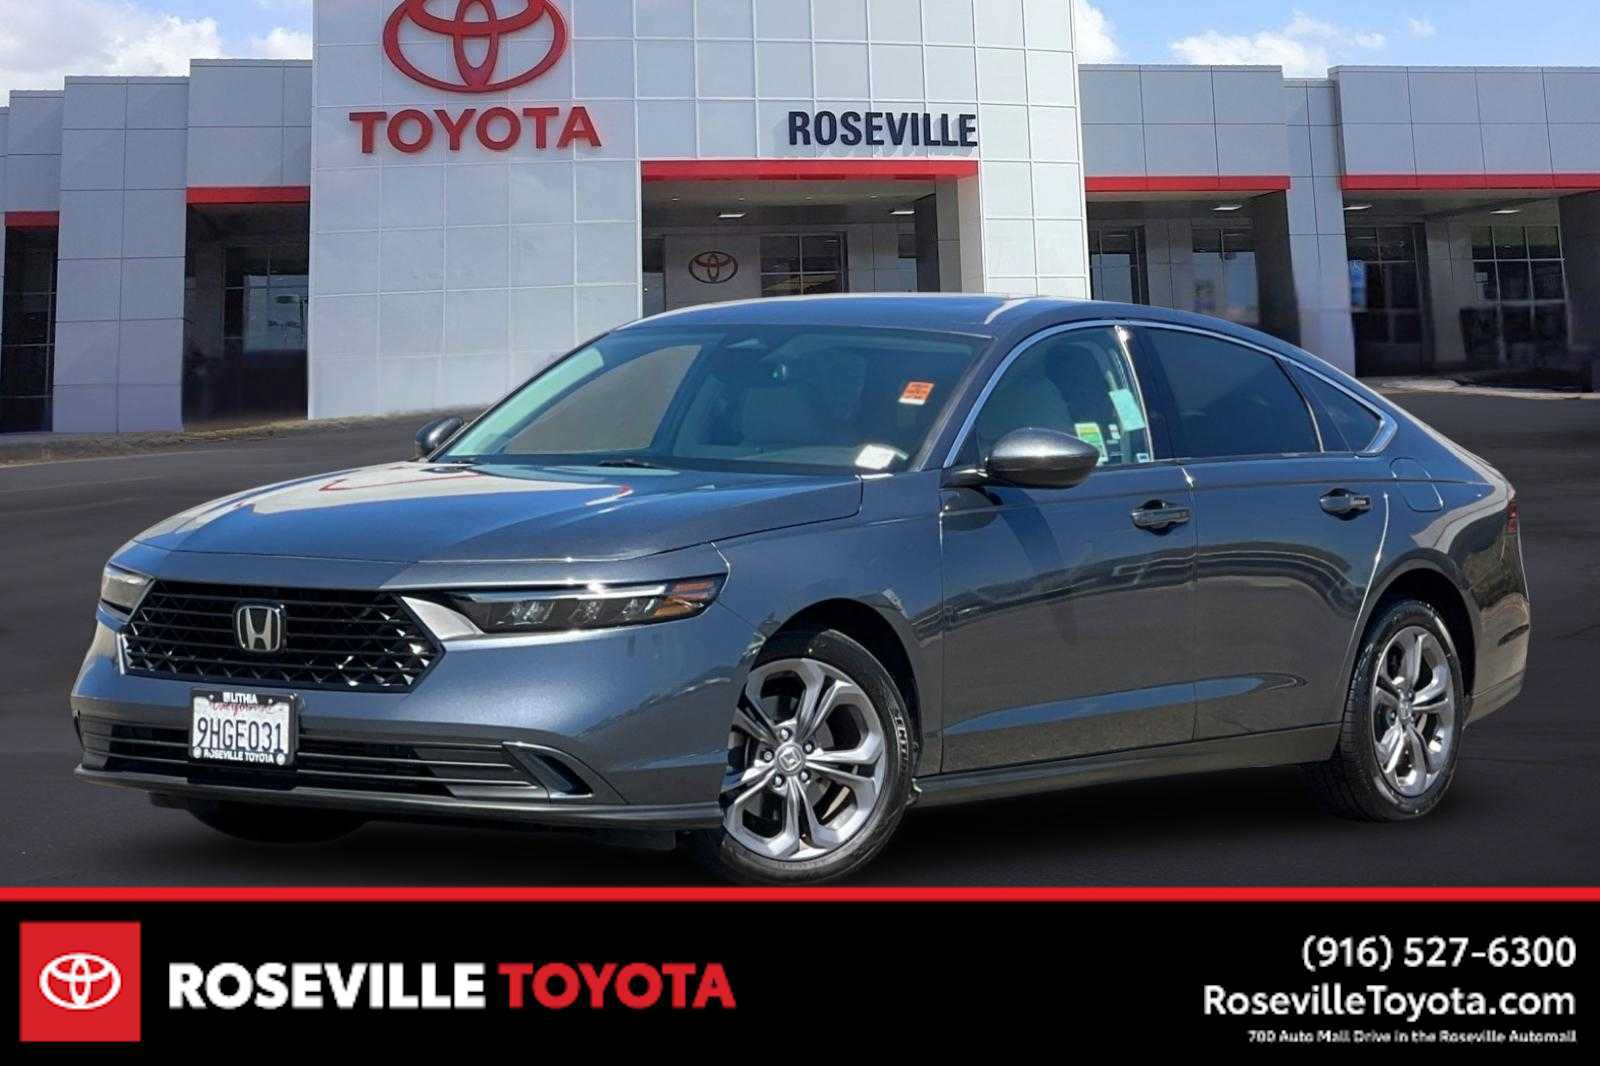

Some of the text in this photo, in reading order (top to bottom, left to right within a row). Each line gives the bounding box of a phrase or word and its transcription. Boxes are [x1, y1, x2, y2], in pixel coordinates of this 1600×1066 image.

[348, 106, 602, 154] TOYOTA
[788, 111, 978, 147] ROSEVILLE
[231, 692, 258, 704] LITHIA
[197, 716, 284, 753] 9HGE031
[203, 749, 275, 763] ROSEVILLE TOYOTA
